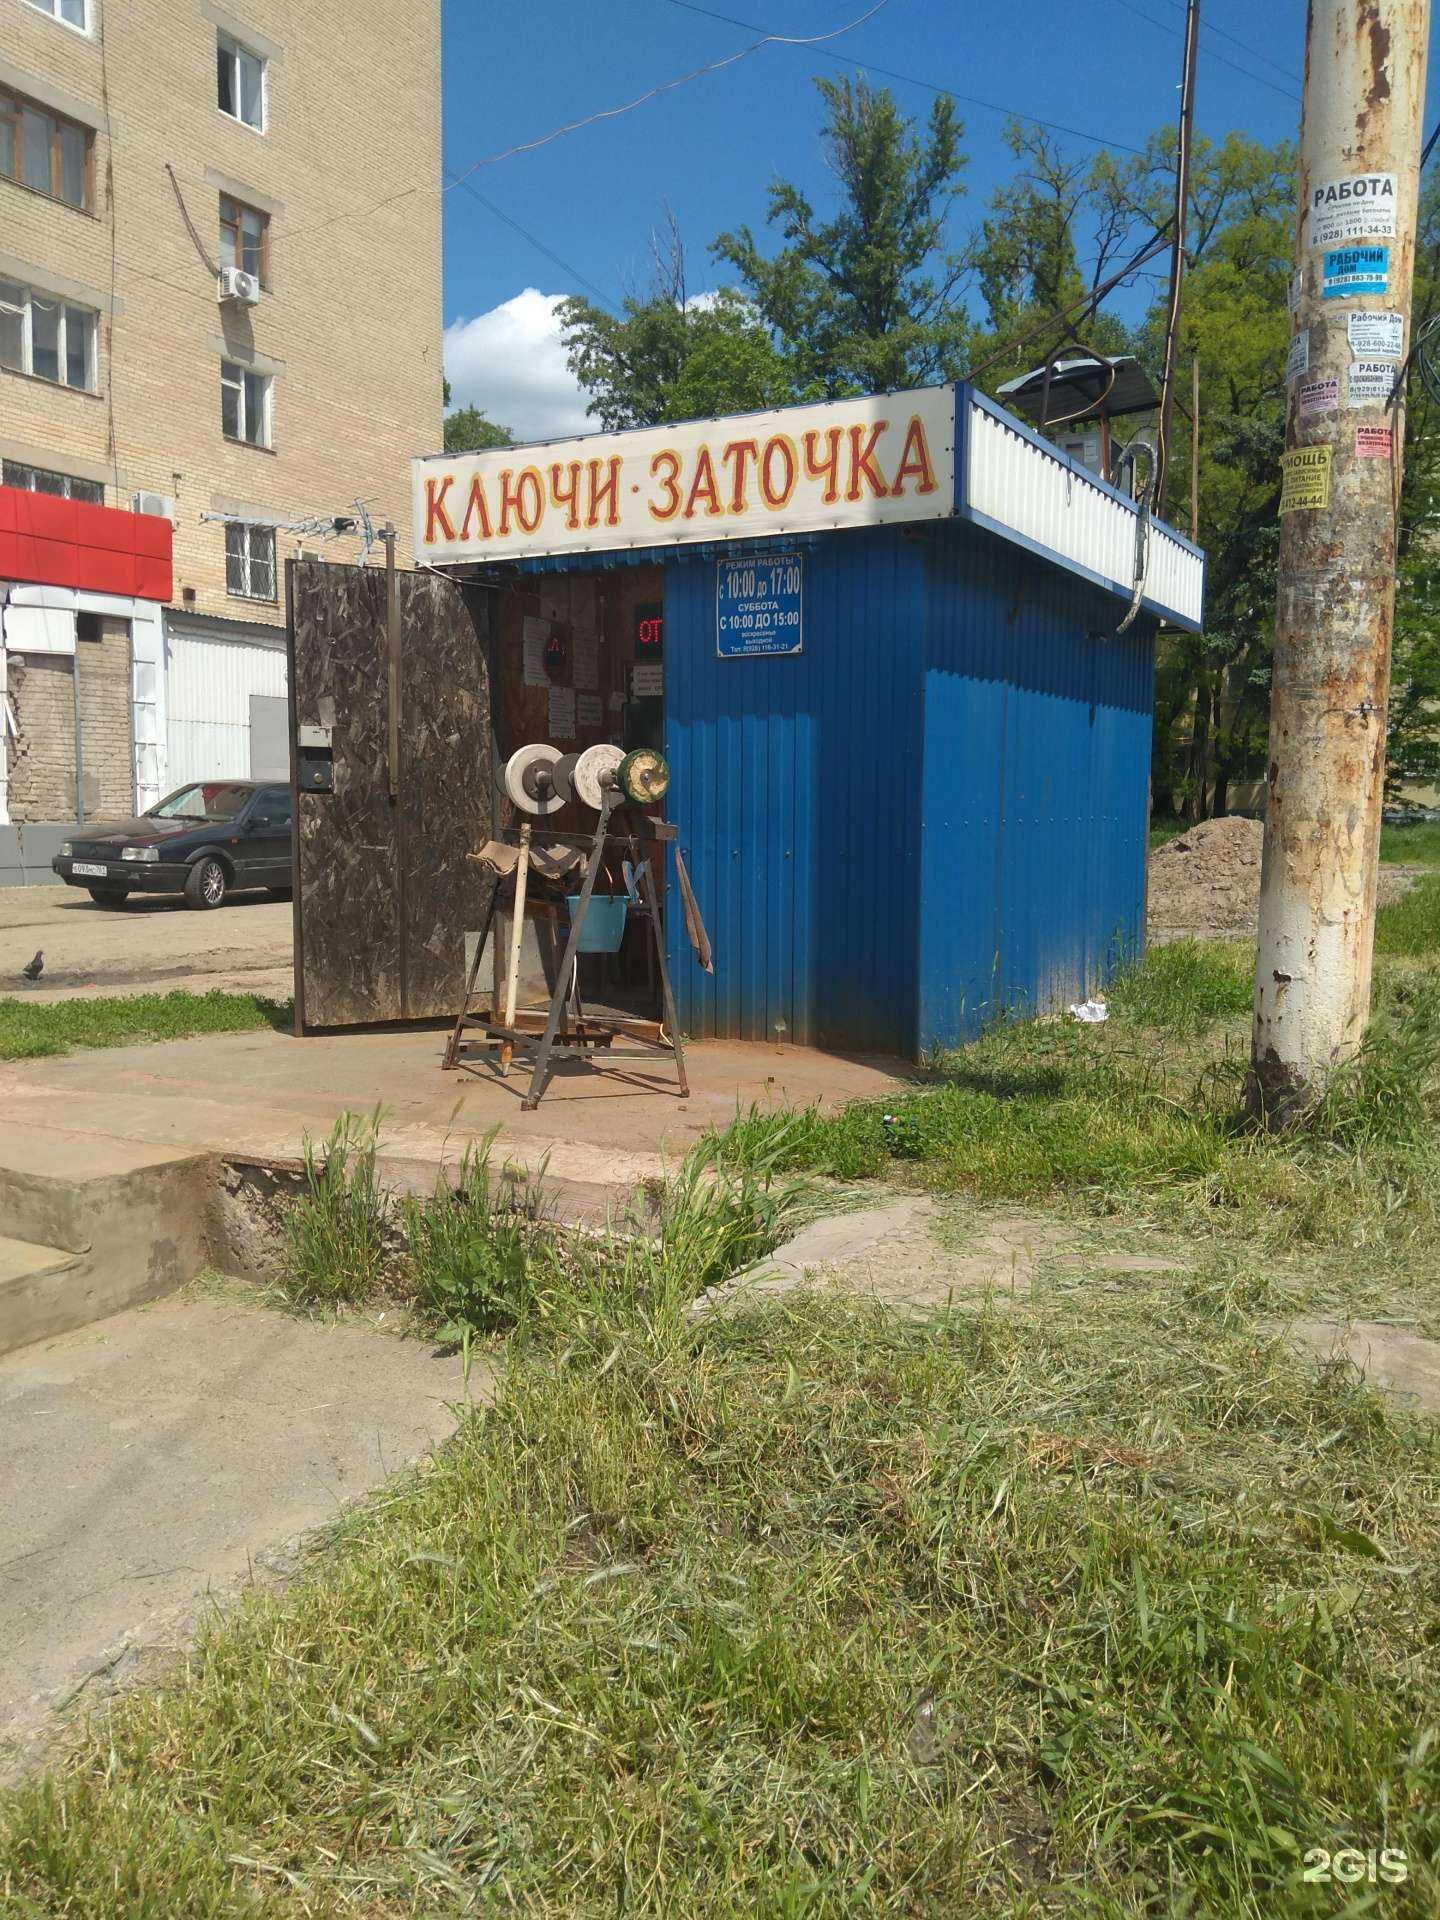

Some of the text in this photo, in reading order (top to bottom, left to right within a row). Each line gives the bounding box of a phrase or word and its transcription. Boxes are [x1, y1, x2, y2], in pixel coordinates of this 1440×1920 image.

[1313, 178, 1394, 208] РАБОТА
[1320, 229, 1343, 243] (928)
[1346, 225, 1392, 236] 111-34-33
[1329, 247, 1384, 266] РАБОЧИЙ
[1337, 264, 1357, 275] ДОМ
[1351, 313, 1387, 322] Рабочий
[1359, 363, 1397, 374] РАБОТА
[1302, 381, 1338, 395] РАБОТА
[1357, 427, 1393, 437] РАБОТА
[1284, 453, 1327, 469] МОЩЬ
[424, 414, 938, 543] КЛЮЧИ ЗАТОЧКА
[726, 557, 794, 570] РЕЖИМ РАБОТЫ
[726, 568, 756, 600] 10:00
[757, 581, 766, 599] до
[771, 566, 800, 595] 17:00
[738, 600, 778, 612] СУББОТА
[729, 614, 753, 630] 10:00
[755, 612, 770, 630] ДО
[773, 611, 799, 627] 15:00
